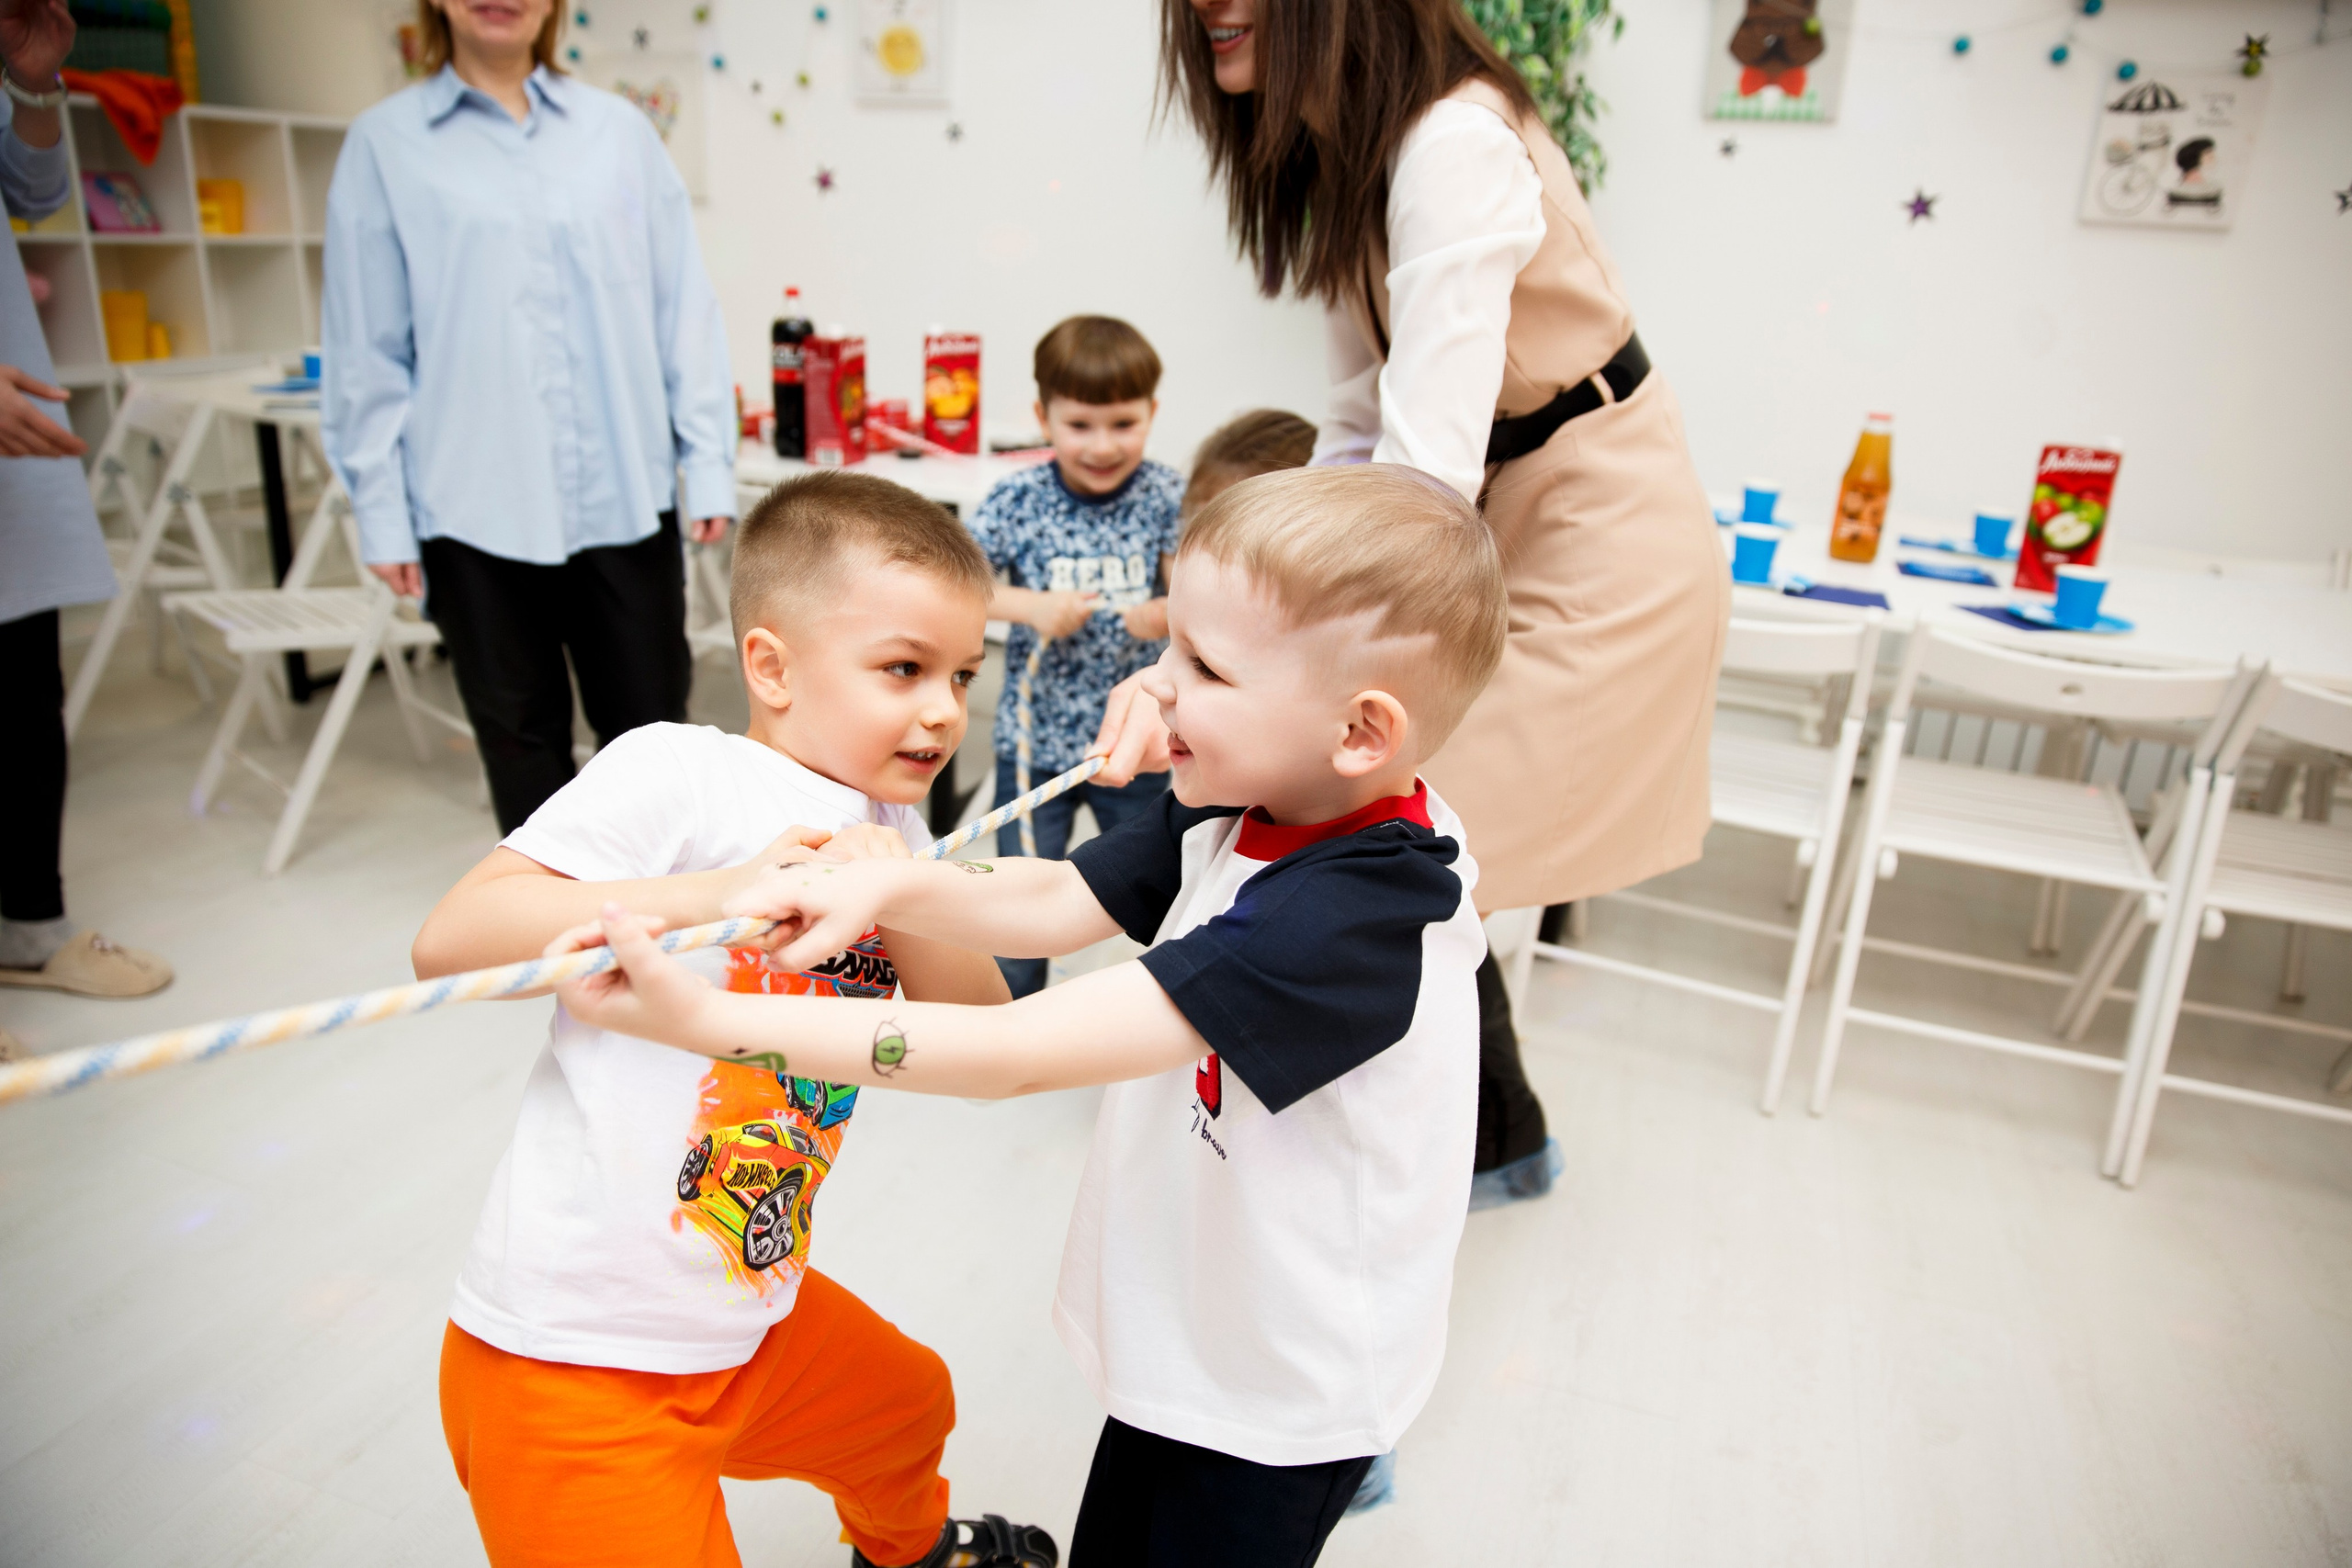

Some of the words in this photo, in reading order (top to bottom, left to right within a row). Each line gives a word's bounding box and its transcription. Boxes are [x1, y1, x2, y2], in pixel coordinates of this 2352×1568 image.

[1048, 554, 1147, 592] HERO
[1201, 1118, 1227, 1160] brave
[726, 1162, 749, 1188] HOT
[741, 1162, 776, 1191] WHEELS
